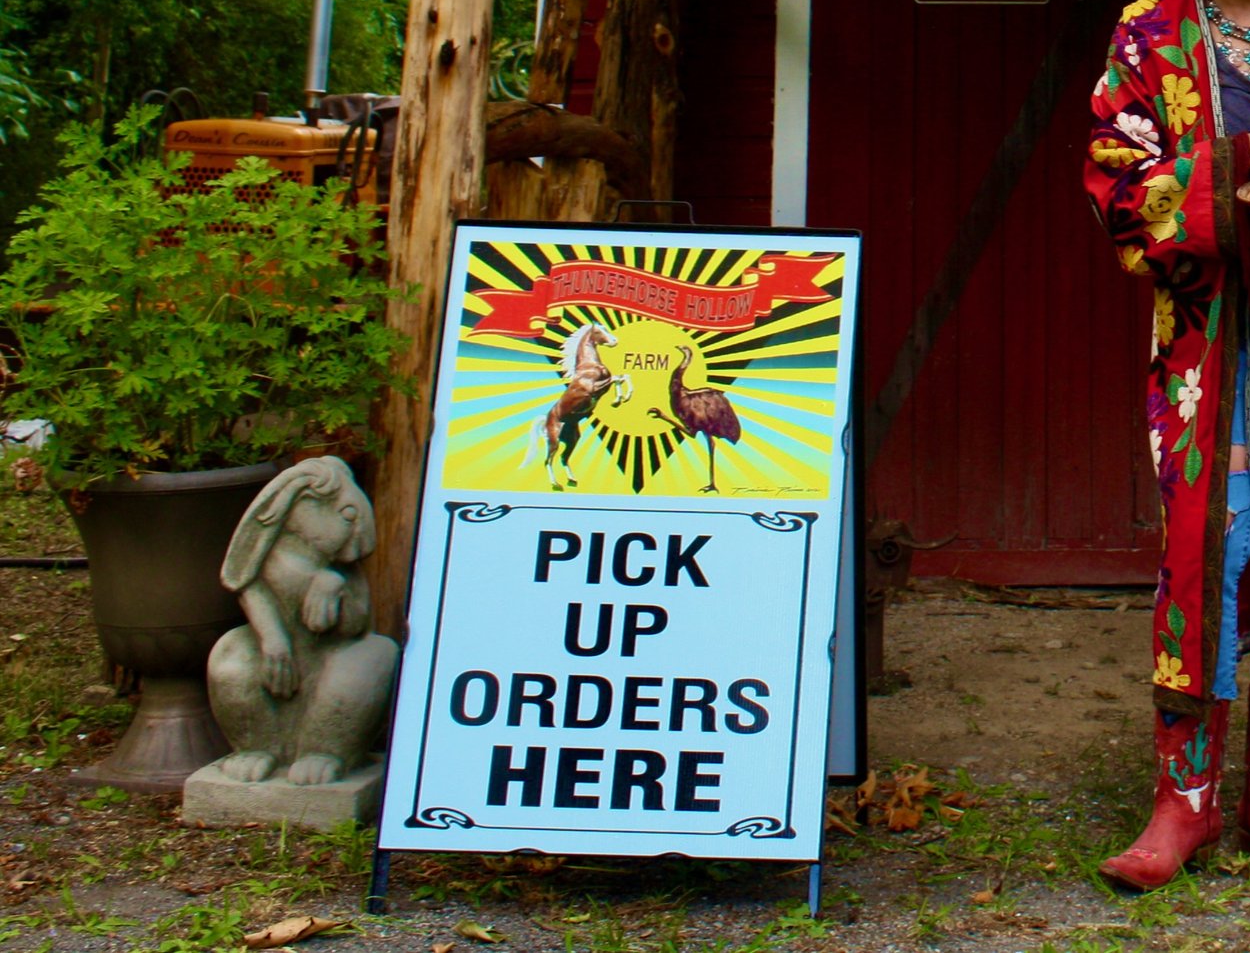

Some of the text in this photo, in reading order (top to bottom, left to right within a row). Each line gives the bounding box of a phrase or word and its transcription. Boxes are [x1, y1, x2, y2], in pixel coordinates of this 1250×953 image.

[551, 270, 756, 323] THUNDERHORSE HOLLOW
[623, 352, 670, 372] FARM
[533, 530, 713, 588] PICK
[563, 602, 669, 658] UP
[449, 669, 771, 735] ORDERS
[486, 744, 726, 813] HERE
